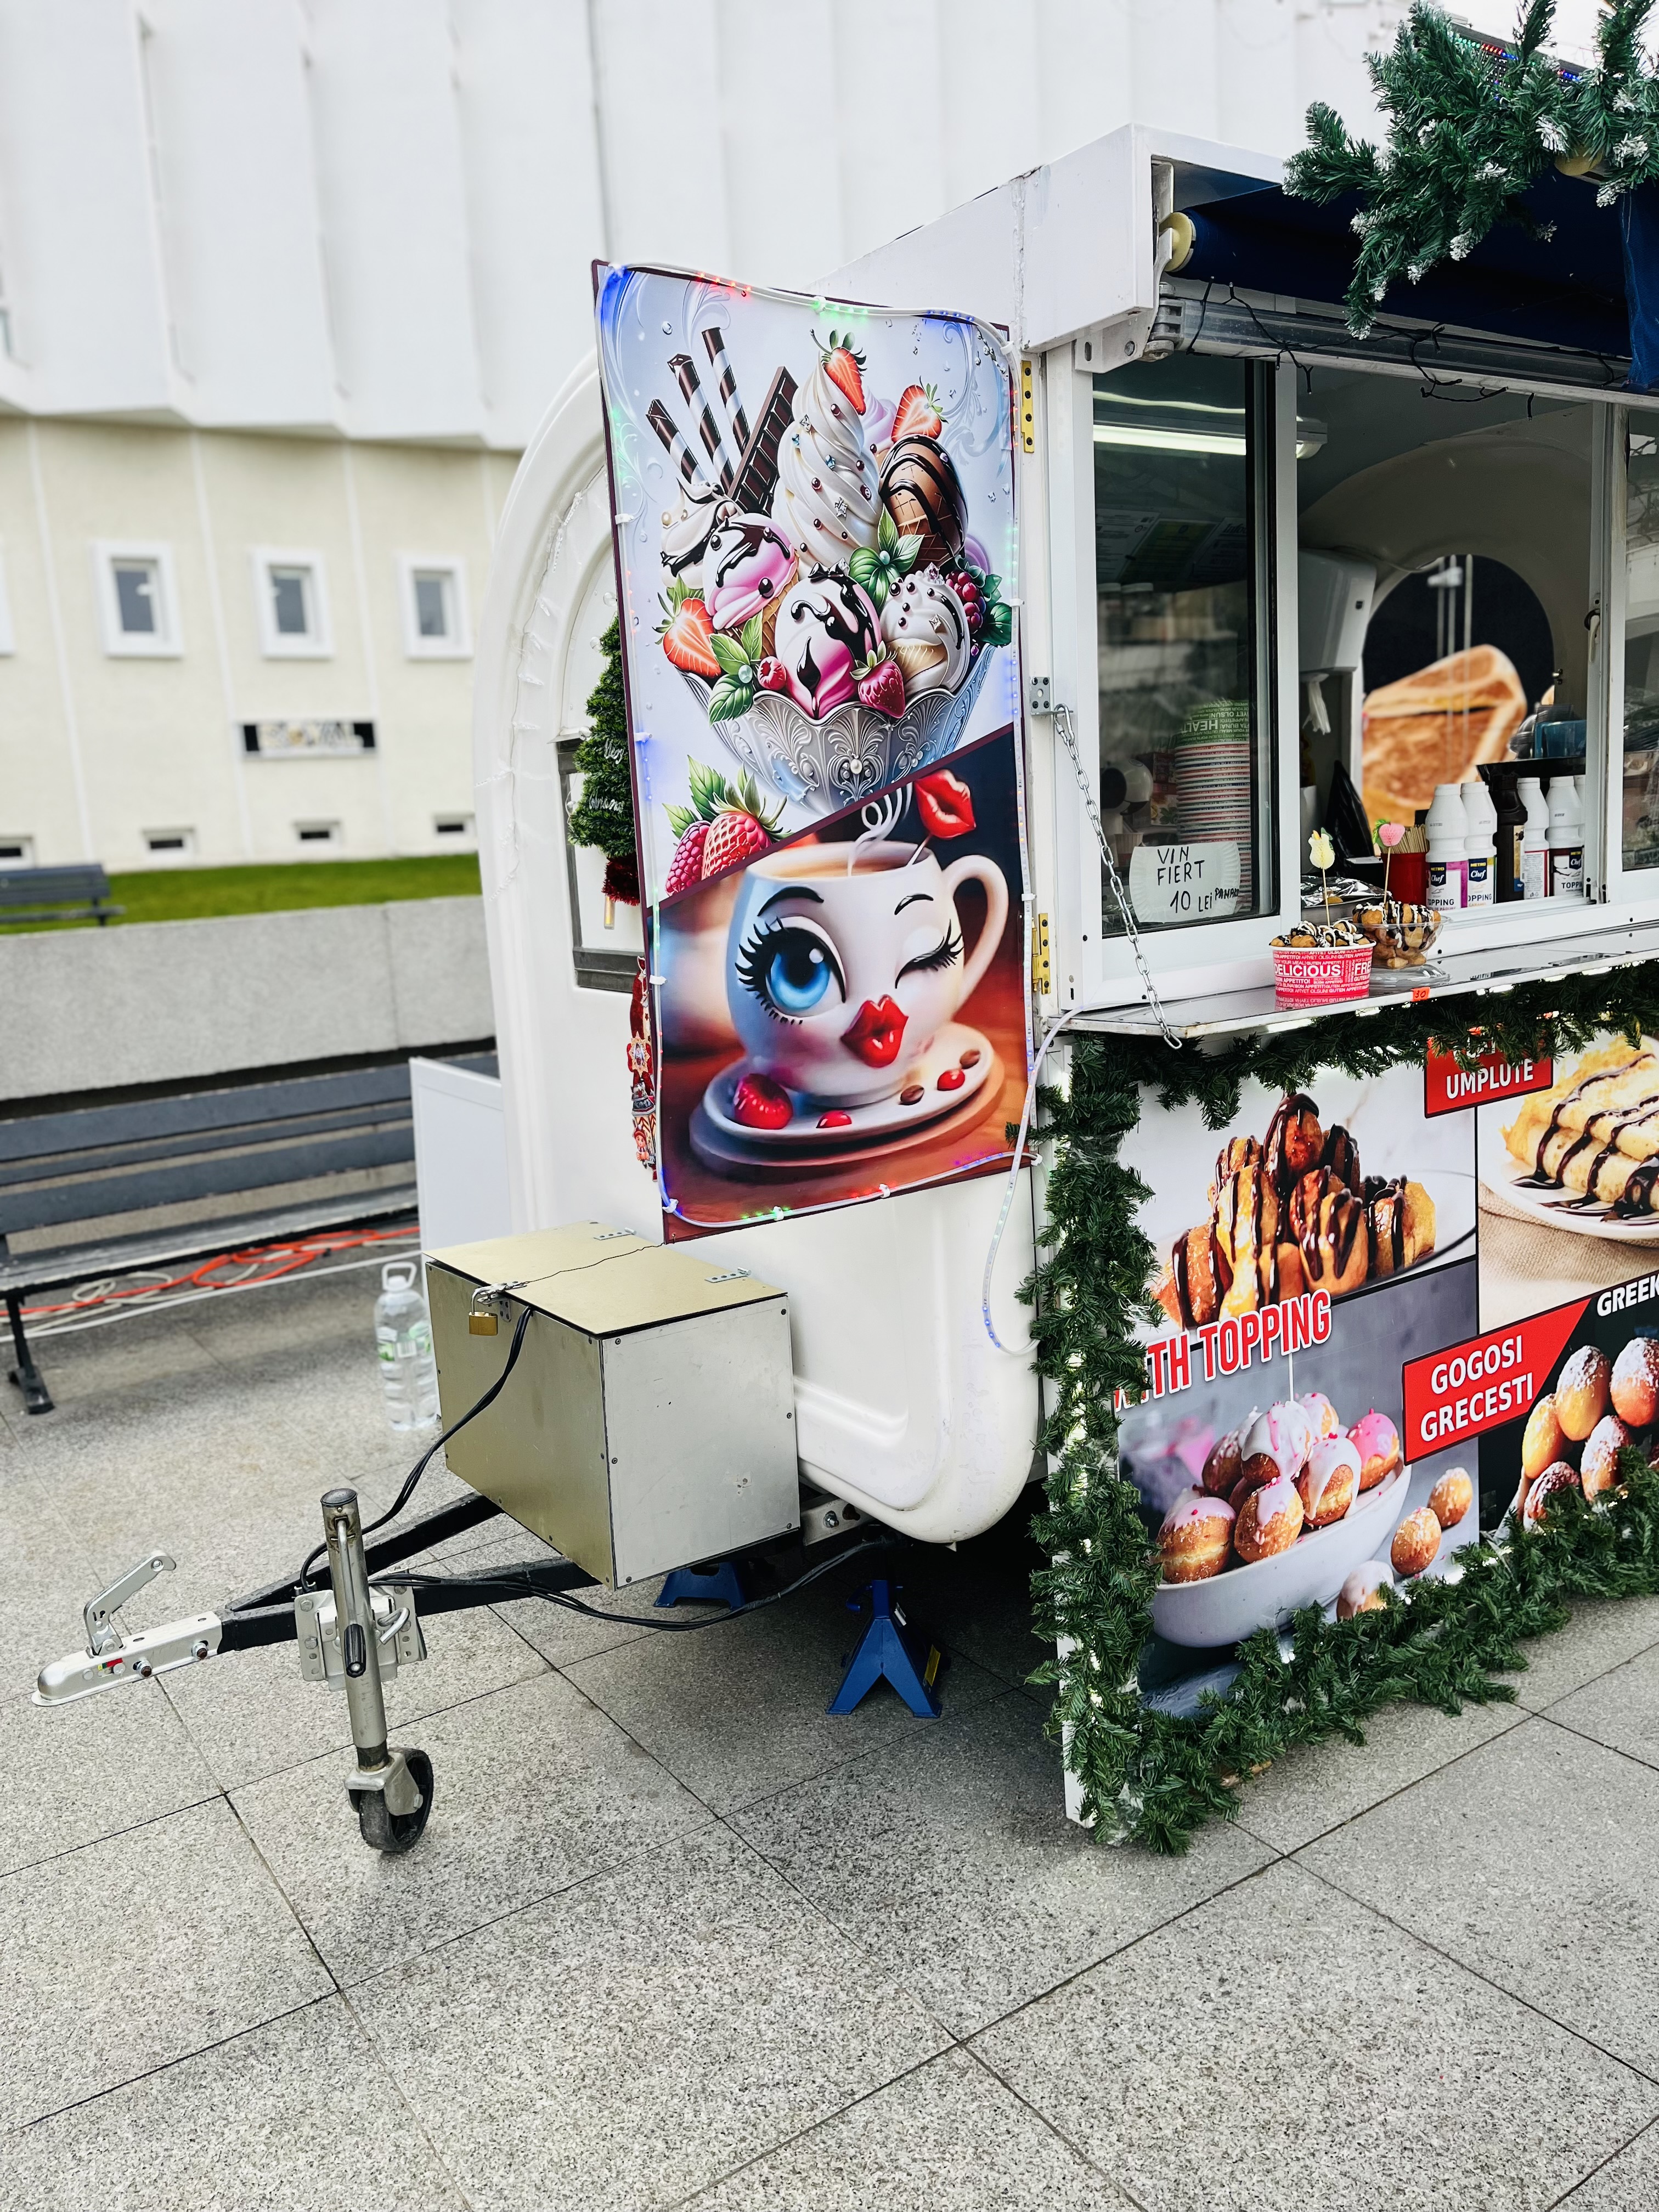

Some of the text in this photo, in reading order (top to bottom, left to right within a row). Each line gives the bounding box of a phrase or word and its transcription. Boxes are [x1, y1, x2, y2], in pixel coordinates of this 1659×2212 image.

[1157, 846, 1189, 864] VIN
[1157, 860, 1205, 886] FIERT
[1431, 874, 1444, 884] Chef
[1470, 869, 1486, 879] Chef
[1170, 890, 1190, 913] 10
[1274, 963, 1341, 977] DELICIOUS
[1415, 990, 1426, 998] 30
[1446, 1058, 1534, 1099] UMPLUTE
[1115, 1288, 1333, 1413] TH TOPPING
[1431, 1334, 1522, 1395] GOGOSI
[1420, 1372, 1533, 1442] GRECESTI
